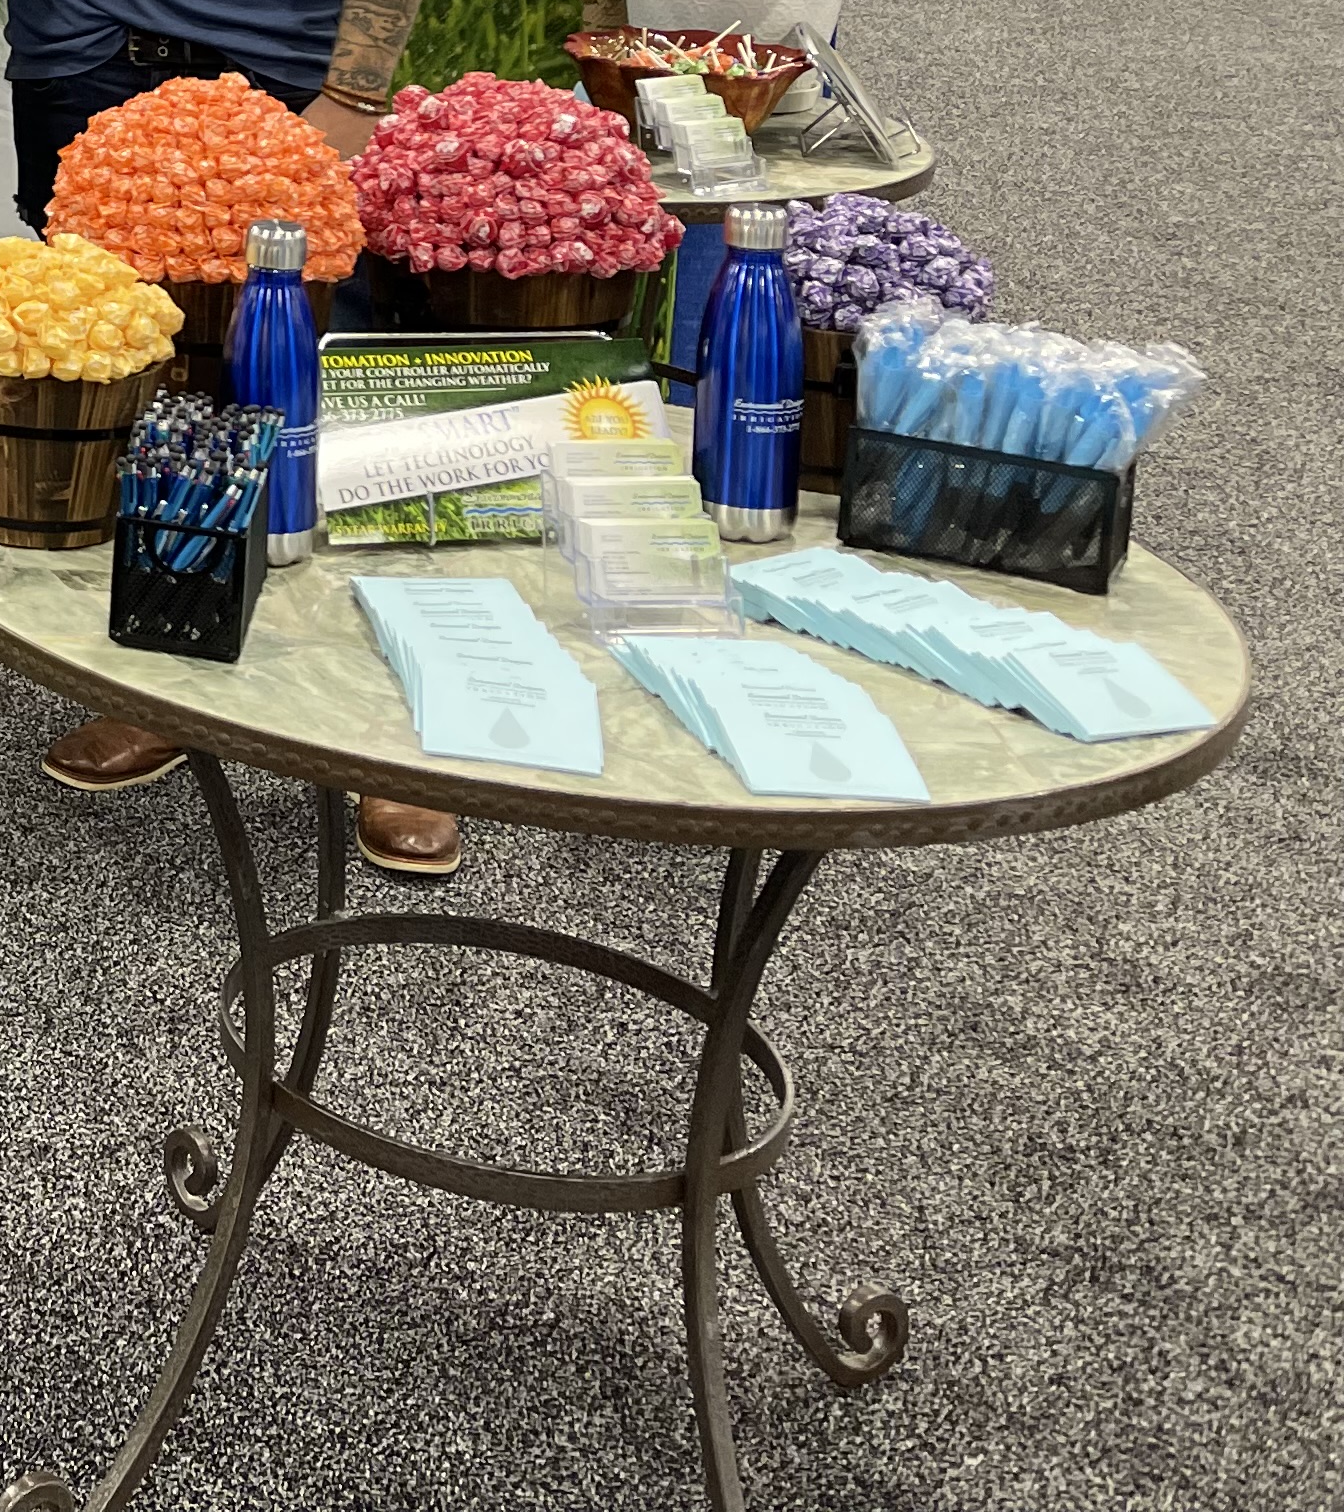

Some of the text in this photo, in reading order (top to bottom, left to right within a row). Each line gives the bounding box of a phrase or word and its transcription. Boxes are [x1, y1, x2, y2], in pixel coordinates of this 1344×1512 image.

[321, 354, 410, 368] TOMATION
[424, 351, 534, 366] INNOVATION
[330, 362, 551, 379] YOUR CONTROLLER AUTOMATICALLY
[340, 379, 366, 390] FOR
[368, 378, 393, 389] THE
[395, 375, 465, 388] CHANGING
[467, 373, 533, 386] WEATHER?
[353, 396, 369, 408] US
[371, 396, 382, 408] A
[384, 394, 427, 407] CALL!
[364, 460, 395, 479] LET
[398, 435, 535, 472] TECHNOLOGY
[338, 485, 370, 504] DO
[374, 476, 414, 497] THE
[417, 465, 480, 489] WORK
[484, 457, 525, 479] FOR
